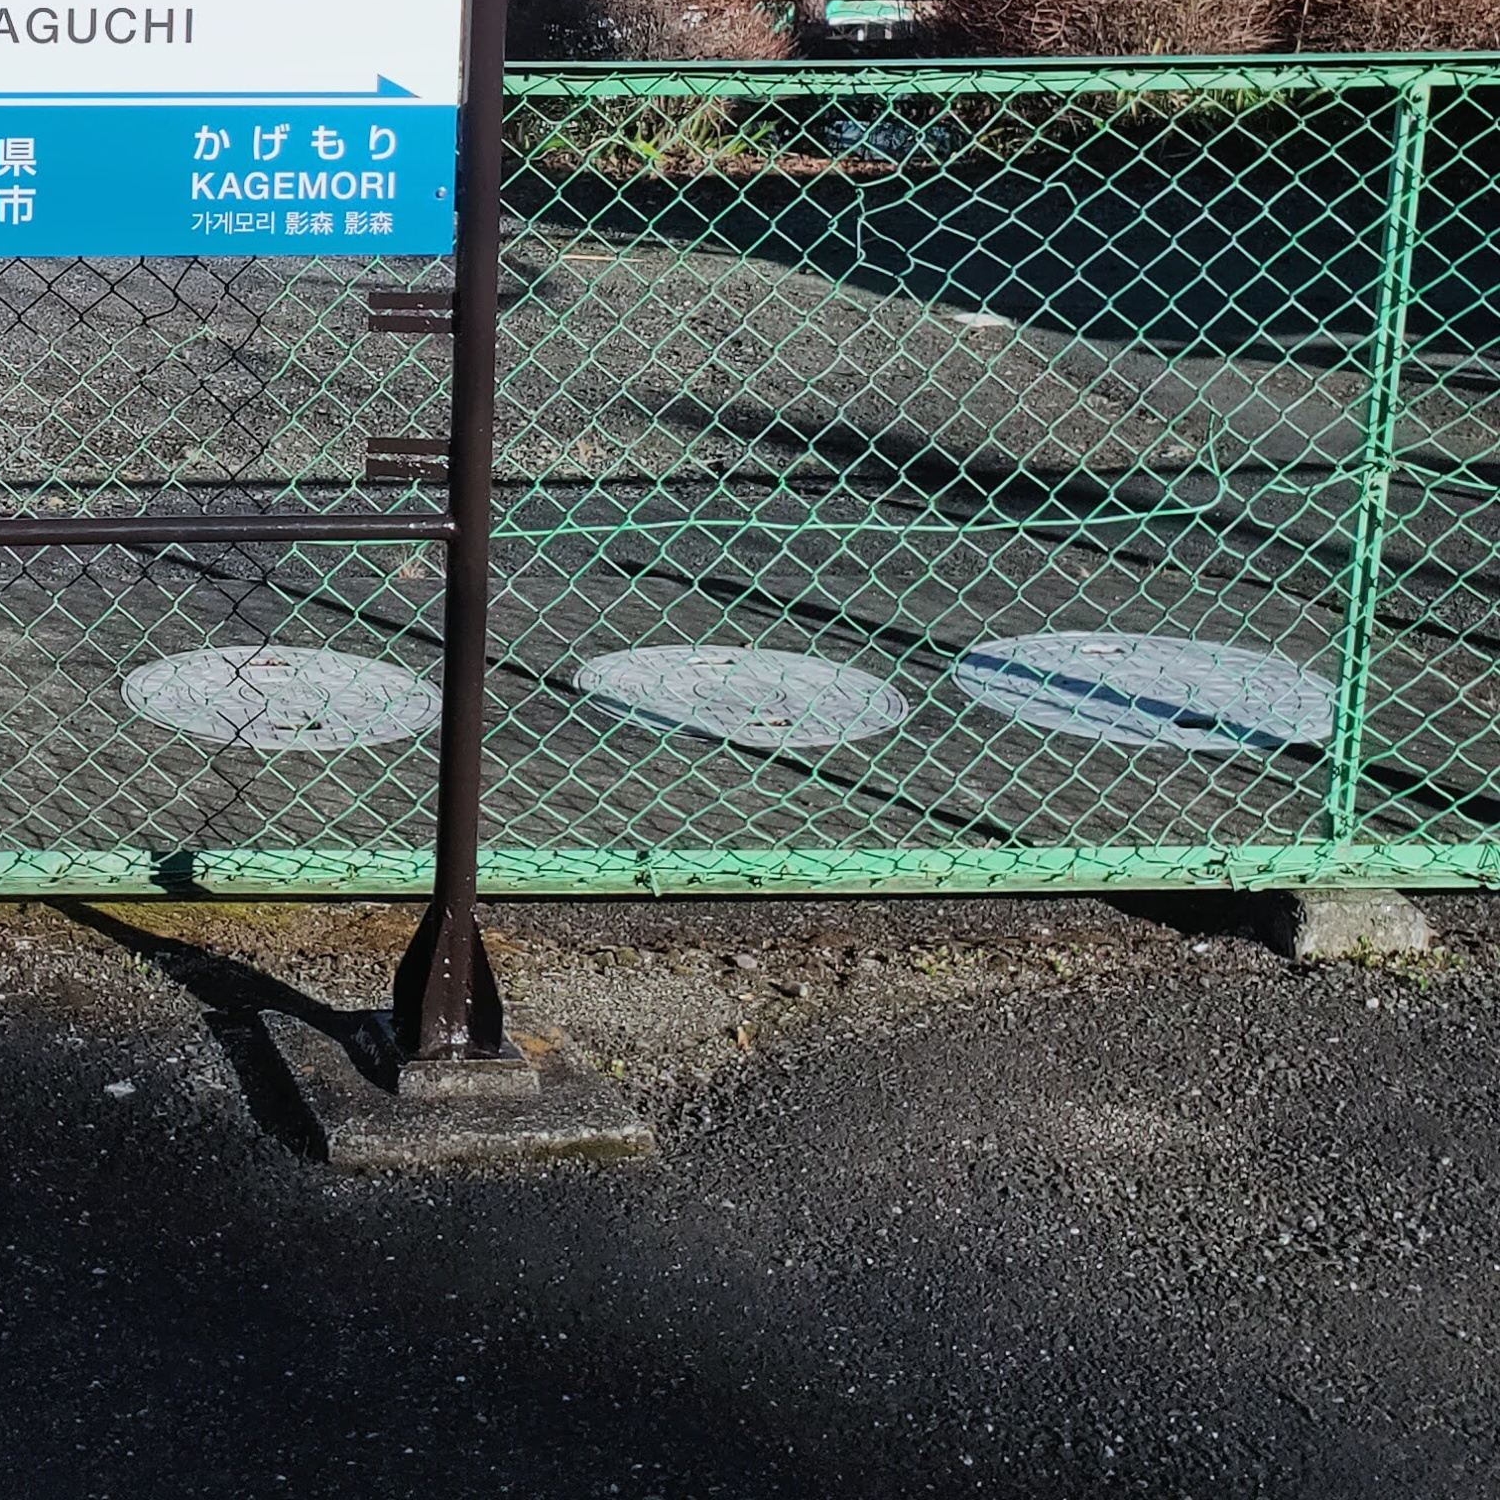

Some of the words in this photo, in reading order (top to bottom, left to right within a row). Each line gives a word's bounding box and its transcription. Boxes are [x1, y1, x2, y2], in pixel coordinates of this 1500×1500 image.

[193, 123, 397, 161] かげもり
[191, 171, 396, 201] KAGEMORI
[191, 211, 275, 235] 가게모리
[285, 211, 334, 236] 影森
[344, 210, 393, 235] 影森
